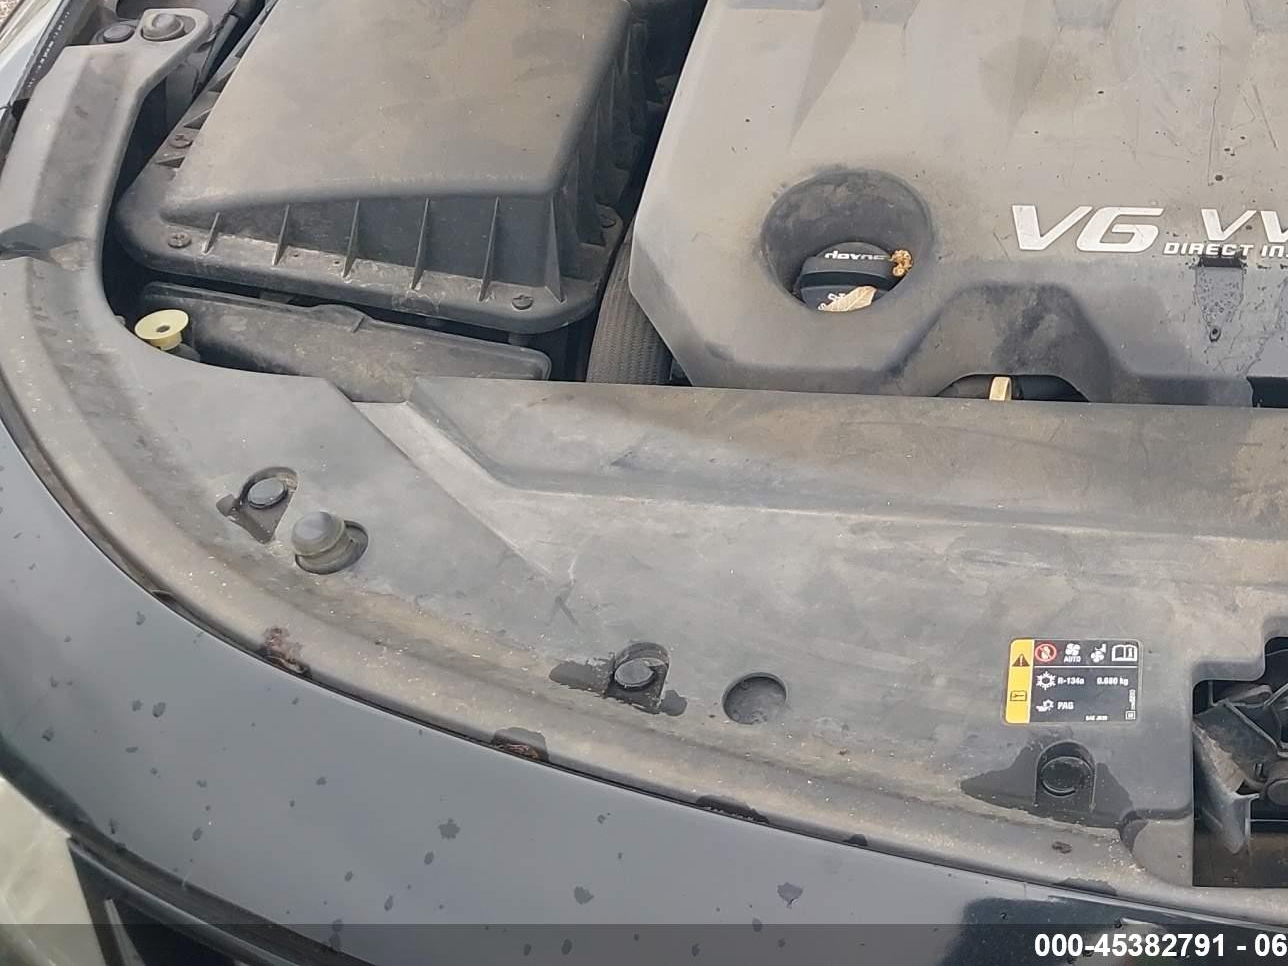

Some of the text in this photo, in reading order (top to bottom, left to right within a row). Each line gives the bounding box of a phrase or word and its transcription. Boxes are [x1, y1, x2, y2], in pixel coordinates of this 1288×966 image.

[1011, 204, 1165, 253] V6
[1163, 241, 1255, 257] DIRECT
[1057, 677, 1085, 685] R-134a
[1119, 676, 1129, 686] kg
[1057, 701, 1075, 710] PAG
